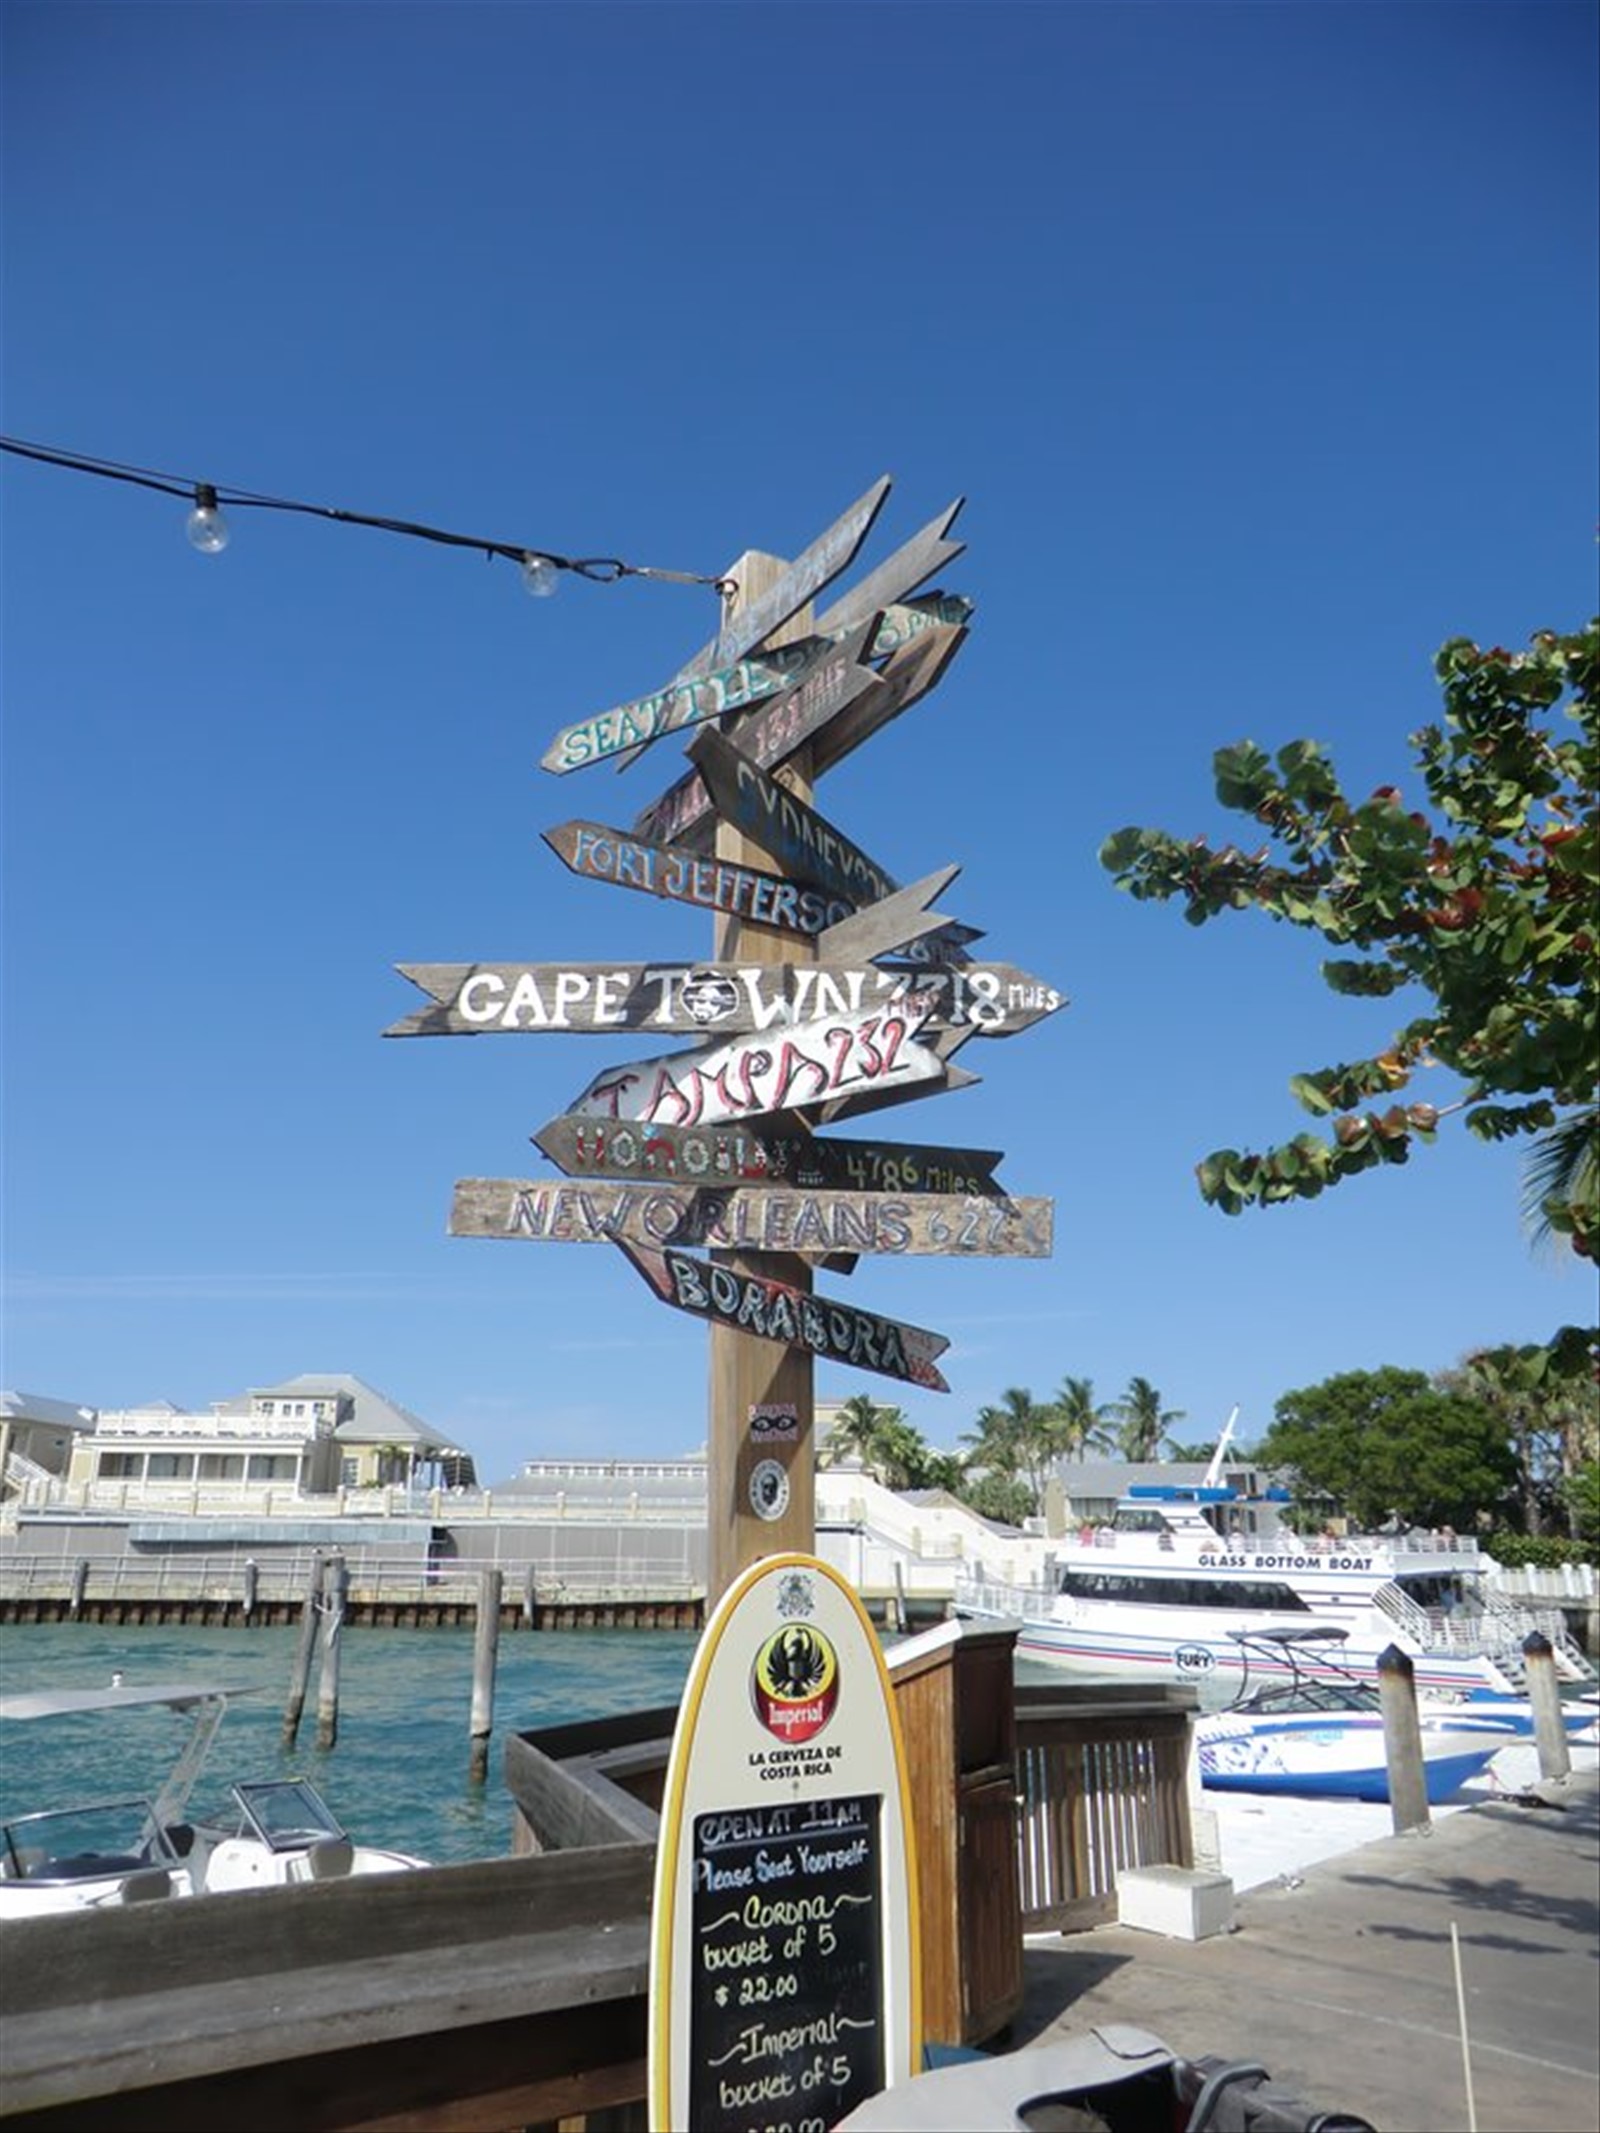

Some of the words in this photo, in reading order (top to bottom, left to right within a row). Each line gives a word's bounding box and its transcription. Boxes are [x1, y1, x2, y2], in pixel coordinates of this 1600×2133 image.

[557, 660, 773, 769] SEATTLE
[572, 829, 657, 890] FORT
[664, 852, 860, 934] JEFFERSO
[457, 971, 631, 1027] CAPE
[642, 968, 866, 1030] TOWN
[591, 1041, 829, 1127] TAMPA
[824, 1016, 910, 1091] 232
[506, 1189, 634, 1237] NEW
[643, 1194, 913, 1252] ORLEANS
[671, 1258, 797, 1341] BORA
[801, 1302, 908, 1375] BORA
[1199, 1554, 1246, 1567] GLASS
[1255, 1556, 1321, 1569] BOTTOM
[1329, 1558, 1373, 1571] BOAT
[1176, 1653, 1210, 1668] FURY
[769, 1702, 823, 1735] Imperial
[749, 1754, 765, 1766] LA
[768, 1749, 822, 1764] CERVEZA
[826, 1746, 842, 1758] DE
[759, 1766, 801, 1781] COSTA
[804, 1762, 832, 1776] RICA
[700, 1810, 763, 1847] OPEN
[767, 1808, 798, 1834] AT
[693, 1857, 752, 1891] Please
[756, 1850, 796, 1882] Seat
[797, 1839, 869, 1873] Yourself
[703, 1936, 773, 1971] bucket
[783, 1925, 807, 1958] of
[818, 1923, 838, 1956] 5
[740, 2012, 839, 2065] Imperial
[719, 2072, 796, 2109] bucket
[801, 2055, 825, 2090] of
[830, 2055, 851, 2086] 5
